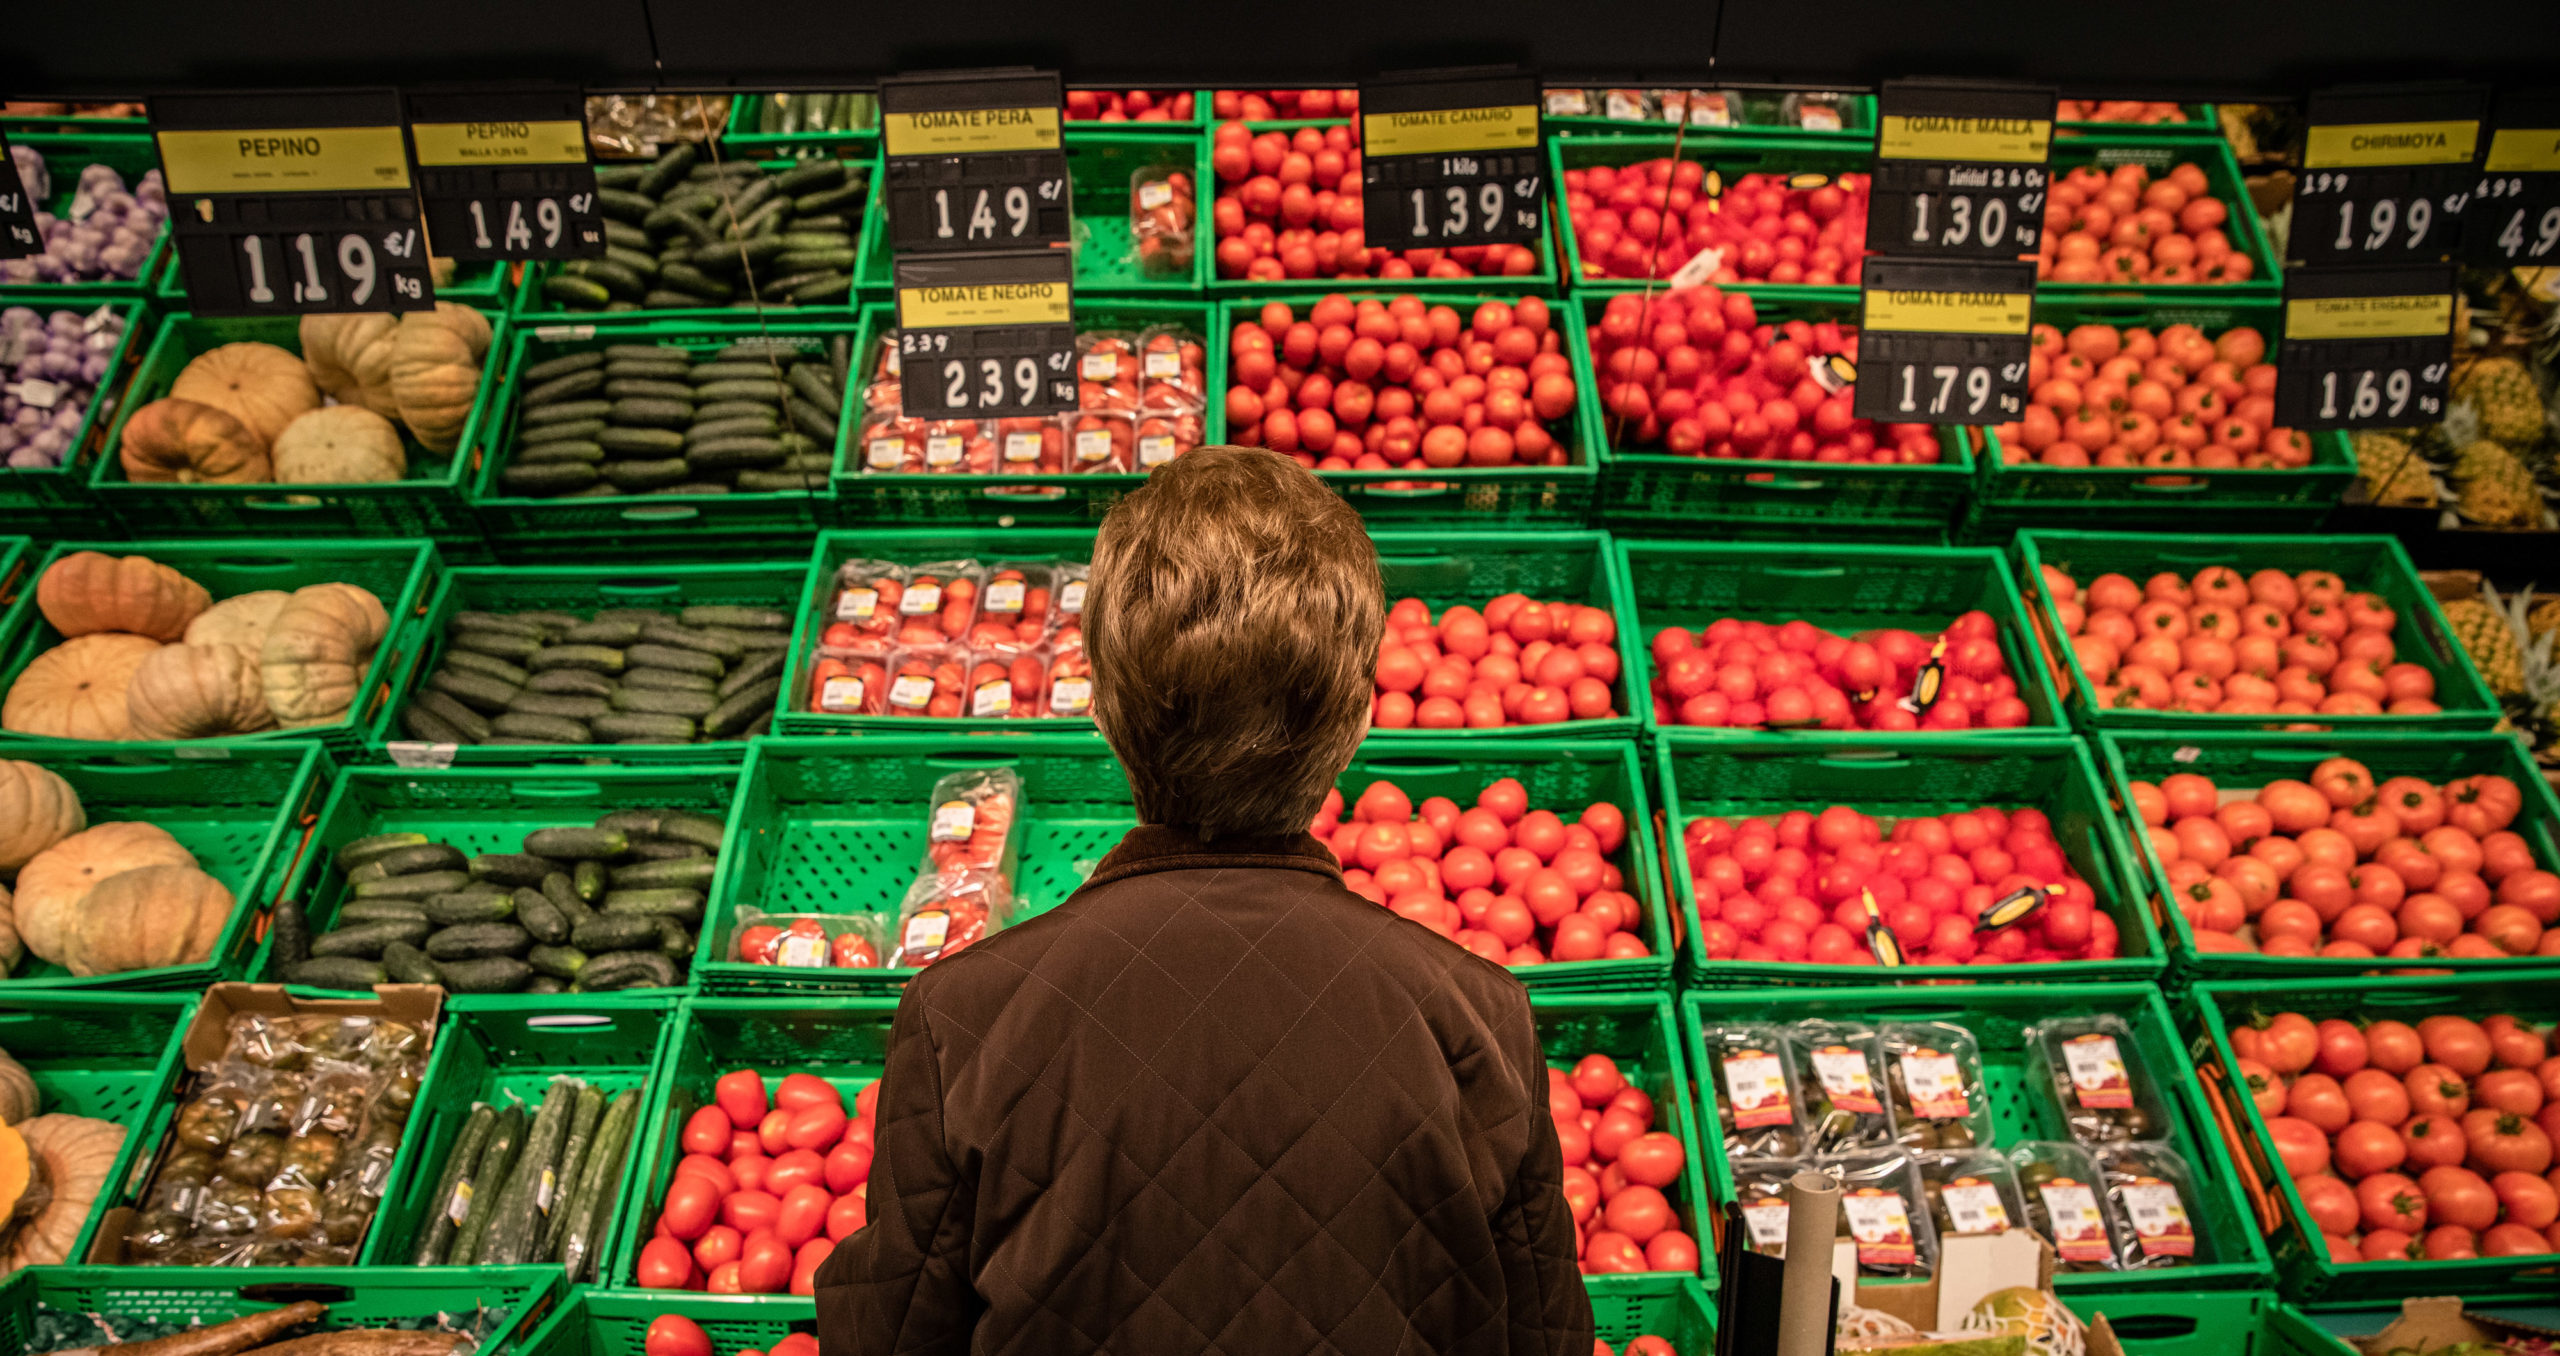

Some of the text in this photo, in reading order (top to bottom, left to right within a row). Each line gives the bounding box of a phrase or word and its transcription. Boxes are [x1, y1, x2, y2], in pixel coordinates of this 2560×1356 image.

[909, 109, 1033, 129] TOMATE PERA
[1391, 108, 1513, 129] TOMATE CANARIO
[1903, 117, 2034, 136] TOMATE MALLA
[466, 122, 529, 140] PEPINO
[238, 137, 320, 157] PEPINO
[2351, 132, 2447, 151] CHIRIMOYA
[11, 225, 33, 244] kg
[394, 273, 422, 298] kg
[918, 284, 1053, 303] TOMATE NEGRO
[1889, 291, 1954, 307] TOMATE
[2315, 297, 2440, 314] TOMATE ENSALADA
[1056, 382, 1075, 402] kg
[2000, 394, 2019, 413] kg
[2419, 395, 2440, 415] kg
